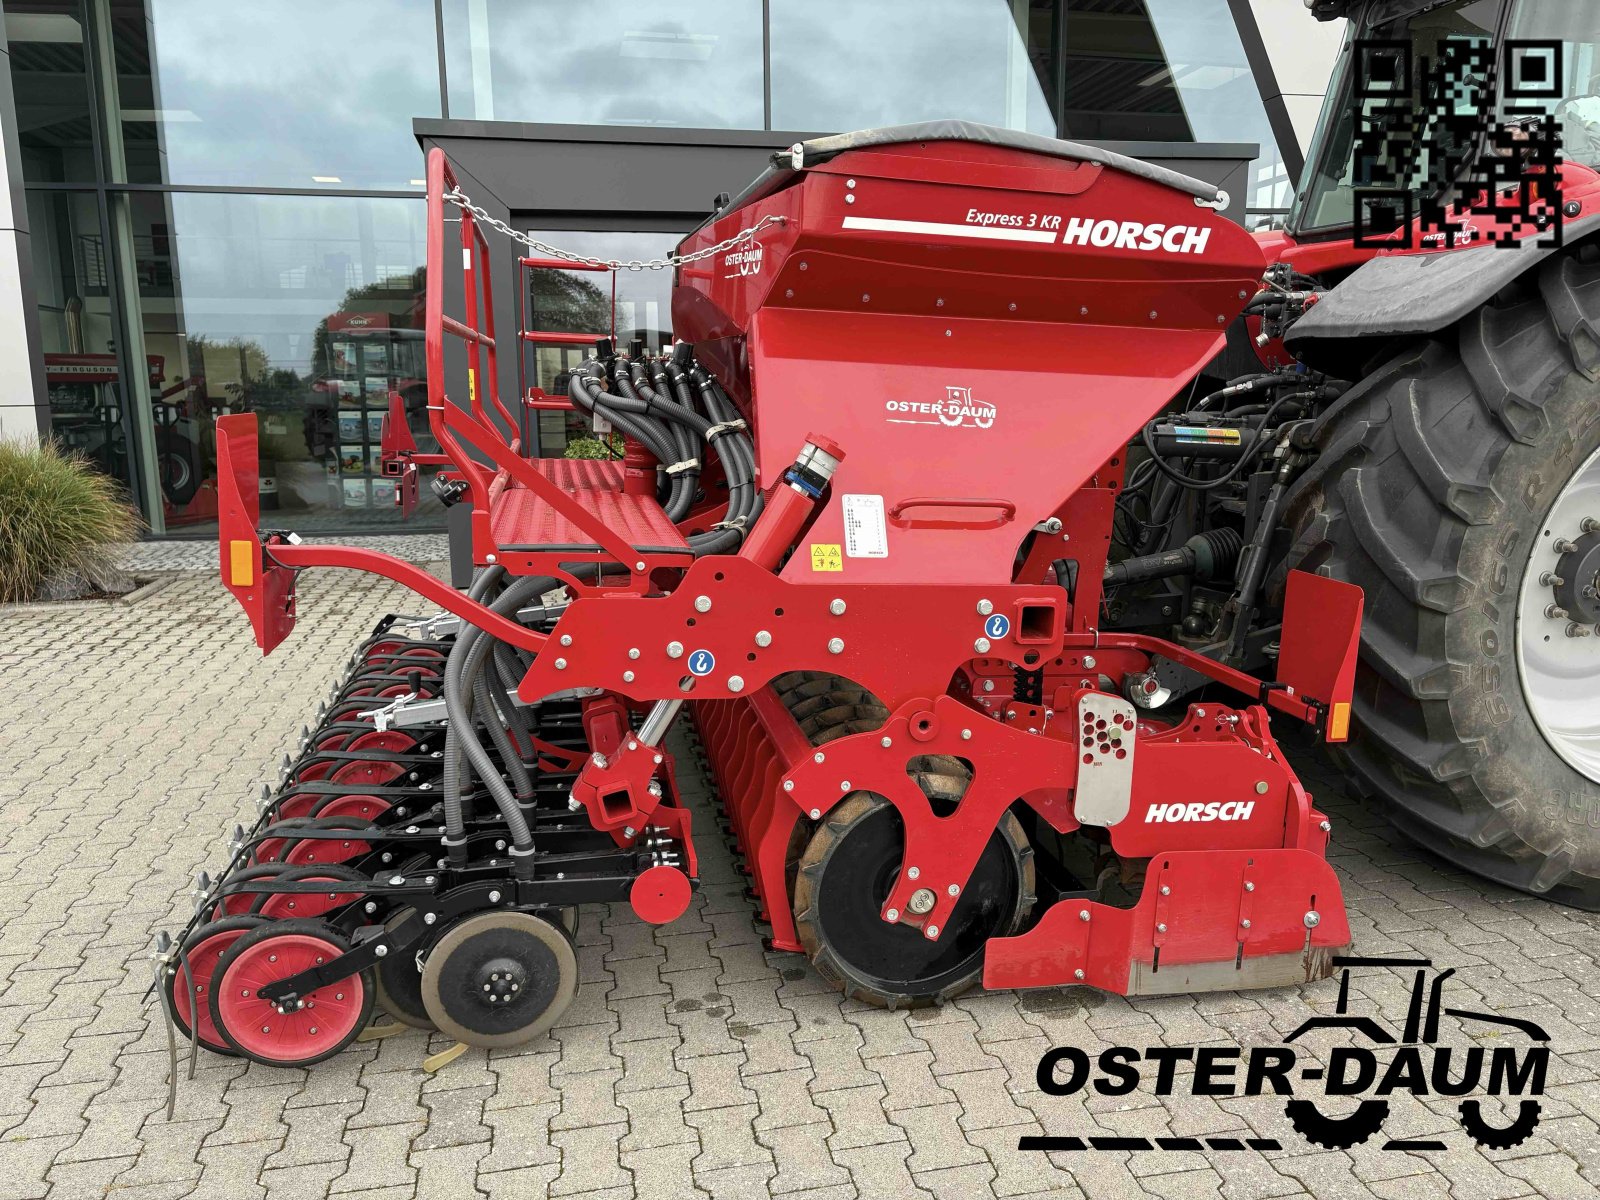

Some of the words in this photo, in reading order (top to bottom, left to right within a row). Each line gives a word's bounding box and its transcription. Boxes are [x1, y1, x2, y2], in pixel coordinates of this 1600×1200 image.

[966, 208, 1024, 226] Express
[1026, 213, 1037, 228] 3
[1040, 214, 1062, 229] KR
[1062, 217, 1212, 254] HORSCH
[725, 248, 763, 267] OSTER-DAUM
[886, 400, 997, 418] OSTER-DAUM
[1144, 801, 1256, 823] HORSCH
